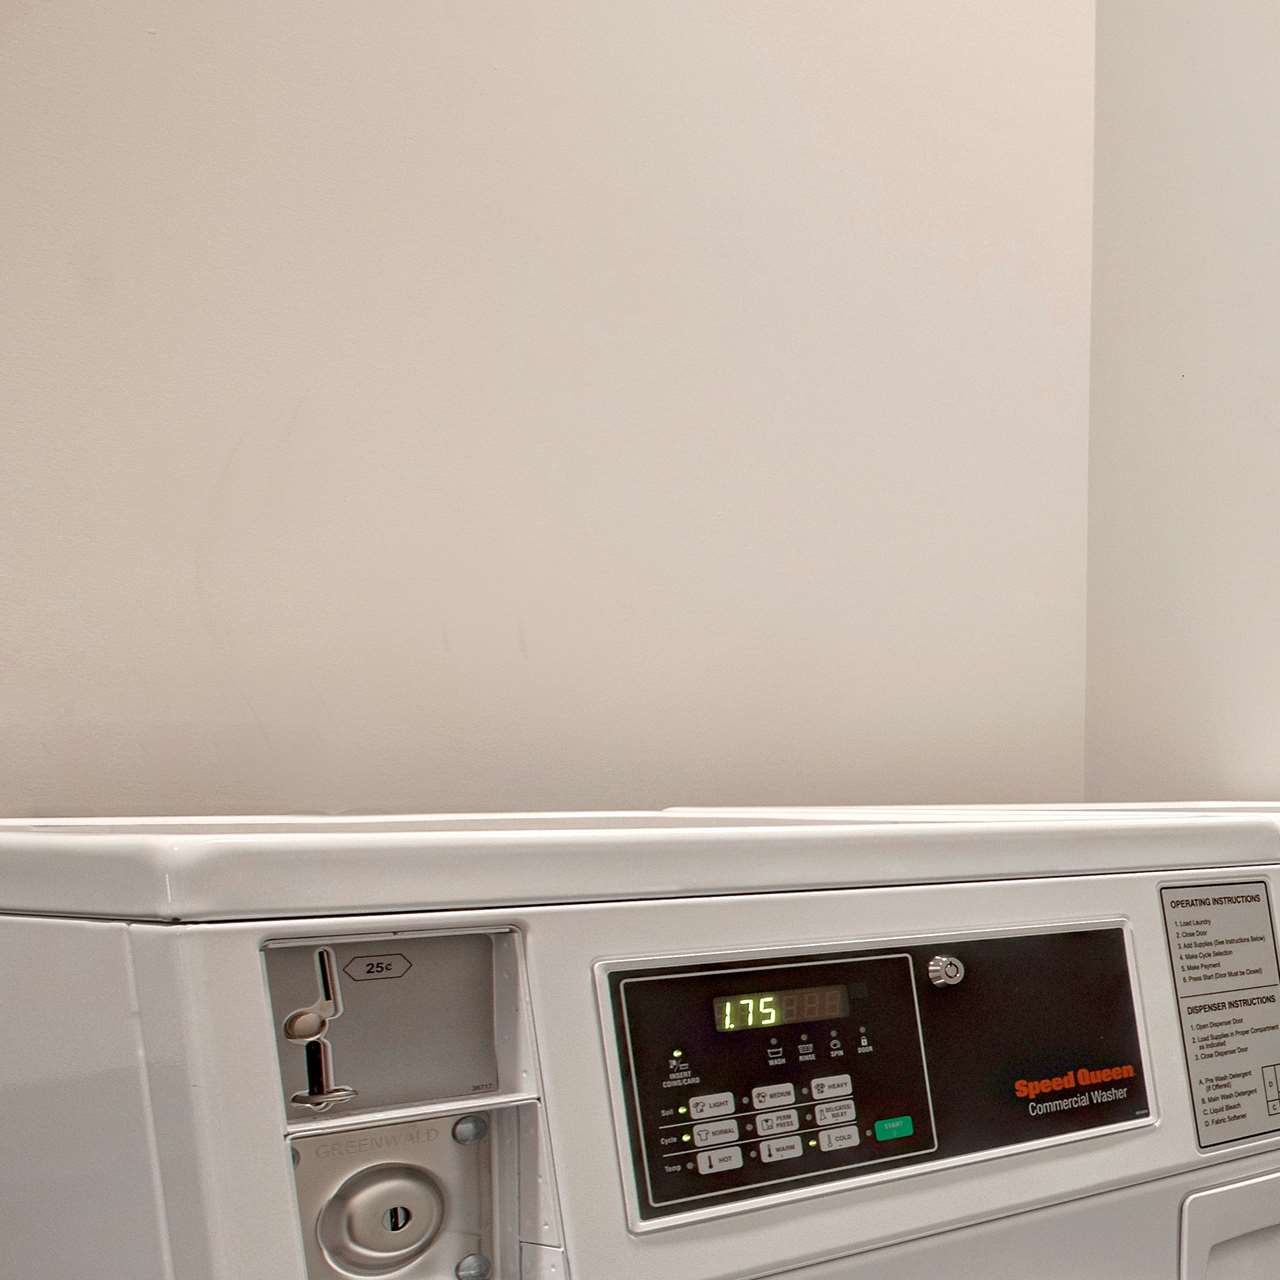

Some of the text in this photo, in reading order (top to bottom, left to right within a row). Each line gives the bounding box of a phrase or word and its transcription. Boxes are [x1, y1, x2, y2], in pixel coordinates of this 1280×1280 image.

[1170, 894, 1261, 909] OPERATING INSTRUCTIONS
[1187, 995, 1277, 1015] DISPENSER INSTRUCTIONS
[724, 996, 777, 1029] 1.75
[828, 1081, 848, 1090] HEAVY
[1014, 1064, 1135, 1100] Speed Queen
[708, 1100, 730, 1110] LIGHT
[1028, 1087, 1128, 1116] Commercial Washer
[884, 1120, 904, 1130] START
[711, 1128, 736, 1137] NORMAL
[660, 1137, 677, 1145] Cycle
[835, 1134, 852, 1143] COLD
[315, 1128, 440, 1160] GREENWALD
[776, 1144, 795, 1153] WARM
[718, 1155, 733, 1164] HOT
[664, 1164, 682, 1173] Temp
